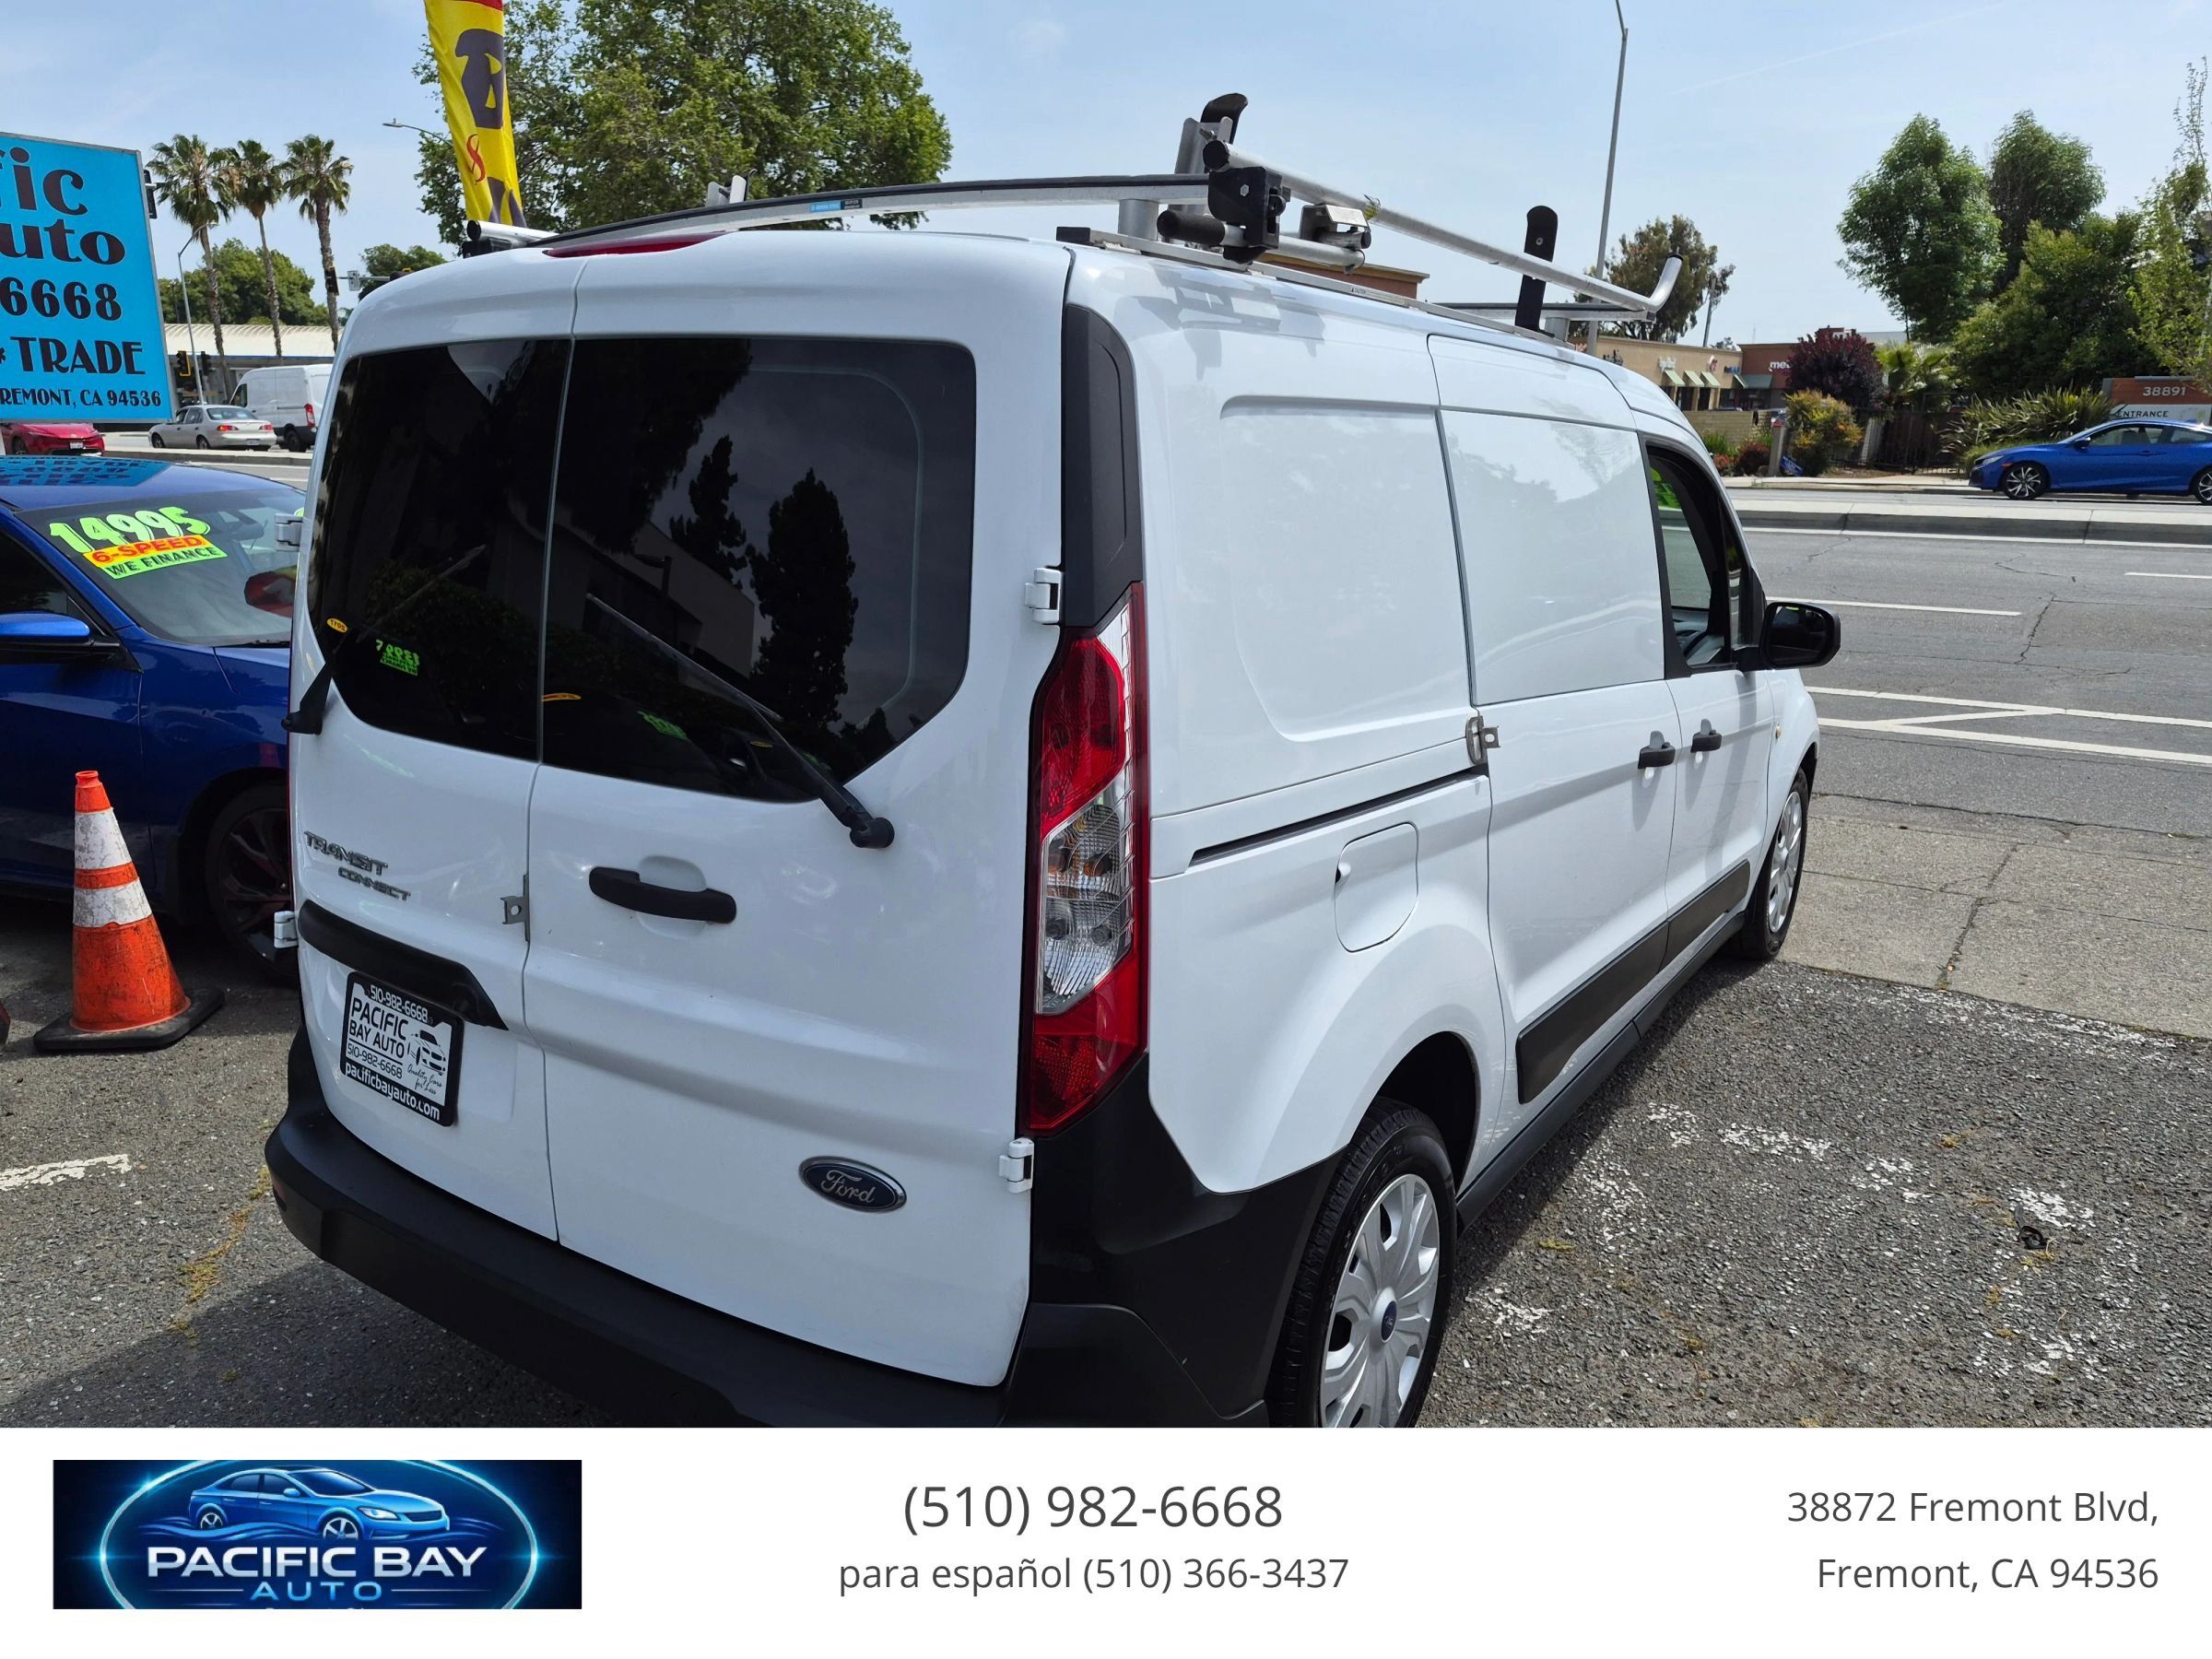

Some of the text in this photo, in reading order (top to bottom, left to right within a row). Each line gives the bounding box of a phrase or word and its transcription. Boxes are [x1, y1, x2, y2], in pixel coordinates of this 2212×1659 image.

[0, 147, 88, 215] ic
[10, 335, 146, 374] TRADE
[80, 390, 103, 406] CA
[107, 390, 161, 406] 94536
[2143, 386, 2185, 396] 38891
[2117, 410, 2168, 418] ENTRANCE
[50, 507, 211, 553] 14995
[92, 535, 205, 563] 6-SPEED
[106, 547, 218, 576] WE FINANCE
[304, 830, 388, 876] TRANSIT
[337, 866, 411, 901] CONNECT
[351, 996, 408, 1041] PACIFIC
[370, 984, 429, 1024] 510-982-6668
[349, 1019, 405, 1059] BAY AUTO
[347, 1042, 403, 1079] 510-982-6668
[407, 1064, 442, 1088] Quality Cars
[345, 1062, 440, 1121] pacificbayauto.com
[820, 1170, 877, 1203] Ford
